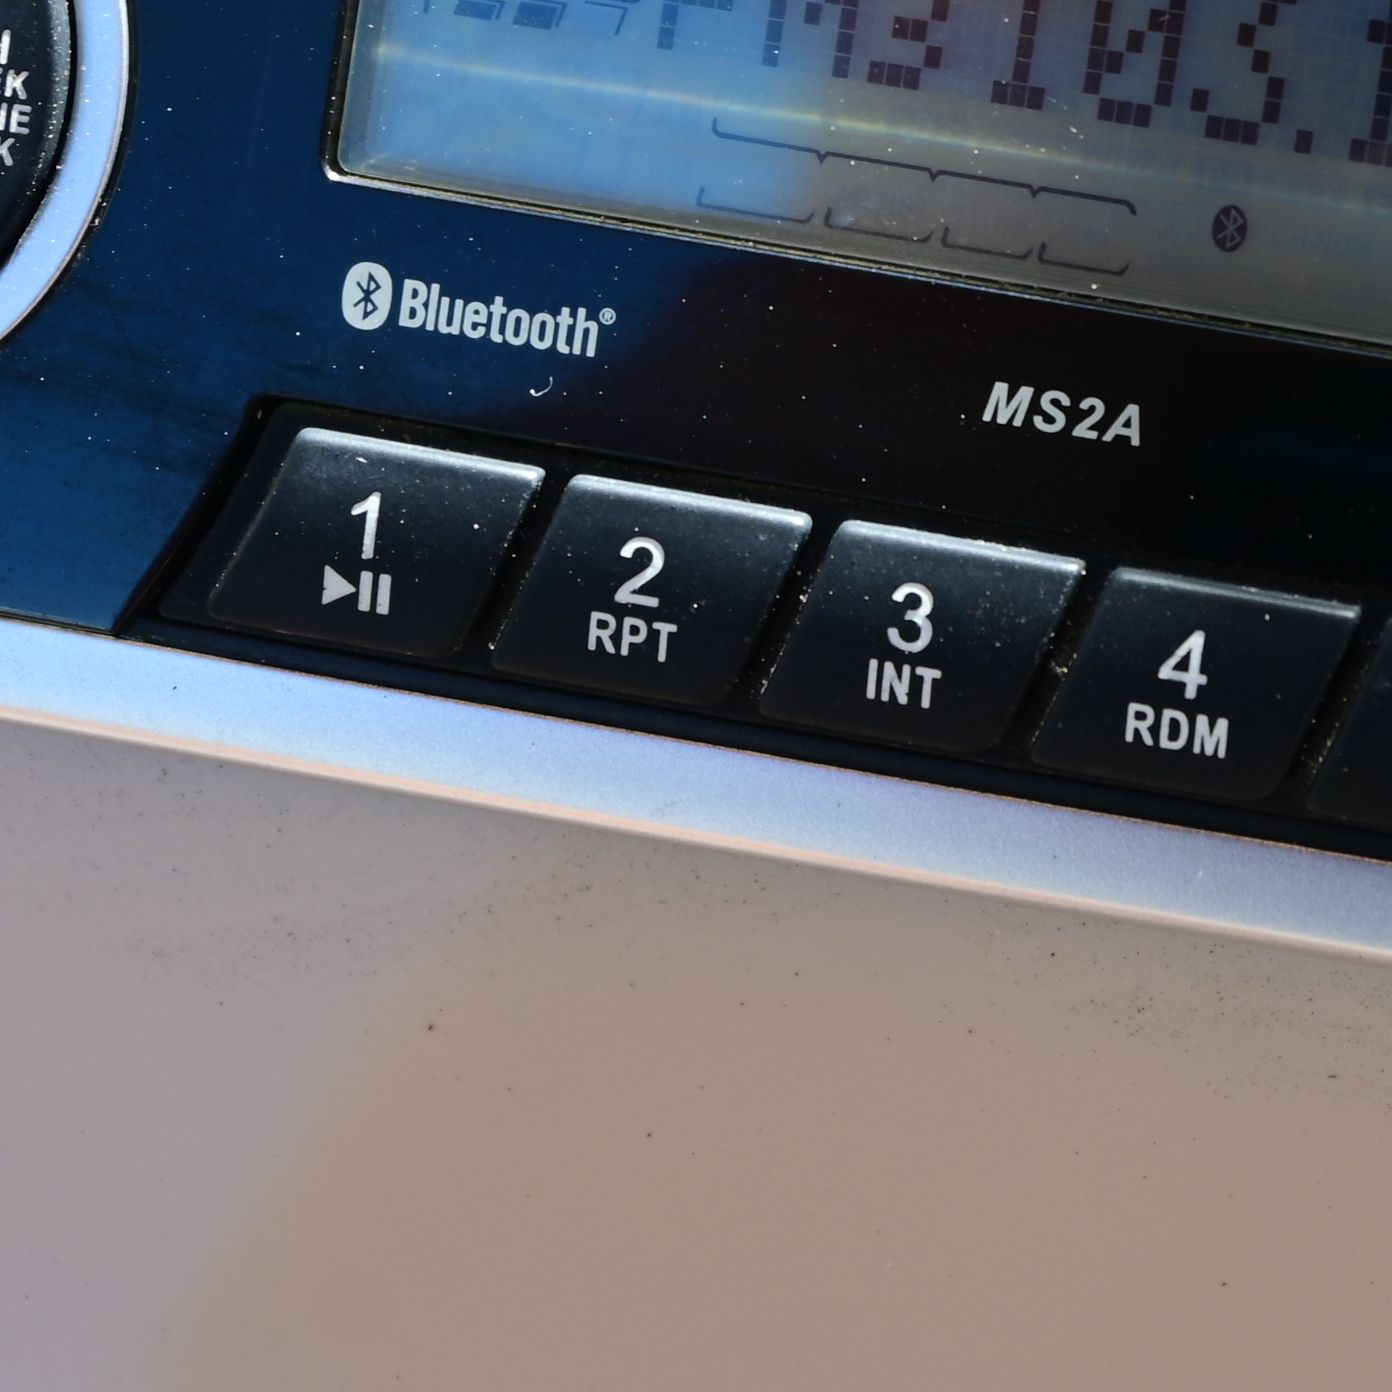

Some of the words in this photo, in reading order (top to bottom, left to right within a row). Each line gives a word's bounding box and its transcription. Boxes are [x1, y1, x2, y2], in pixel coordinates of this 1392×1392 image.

[982, 382, 1139, 446] MS2A
[351, 492, 381, 559] 1
[615, 537, 664, 607] 2
[588, 611, 677, 662] RPT
[888, 583, 933, 654] 3
[867, 659, 941, 708] INT
[1158, 631, 1207, 699] 4
[1125, 703, 1228, 758] RDM
